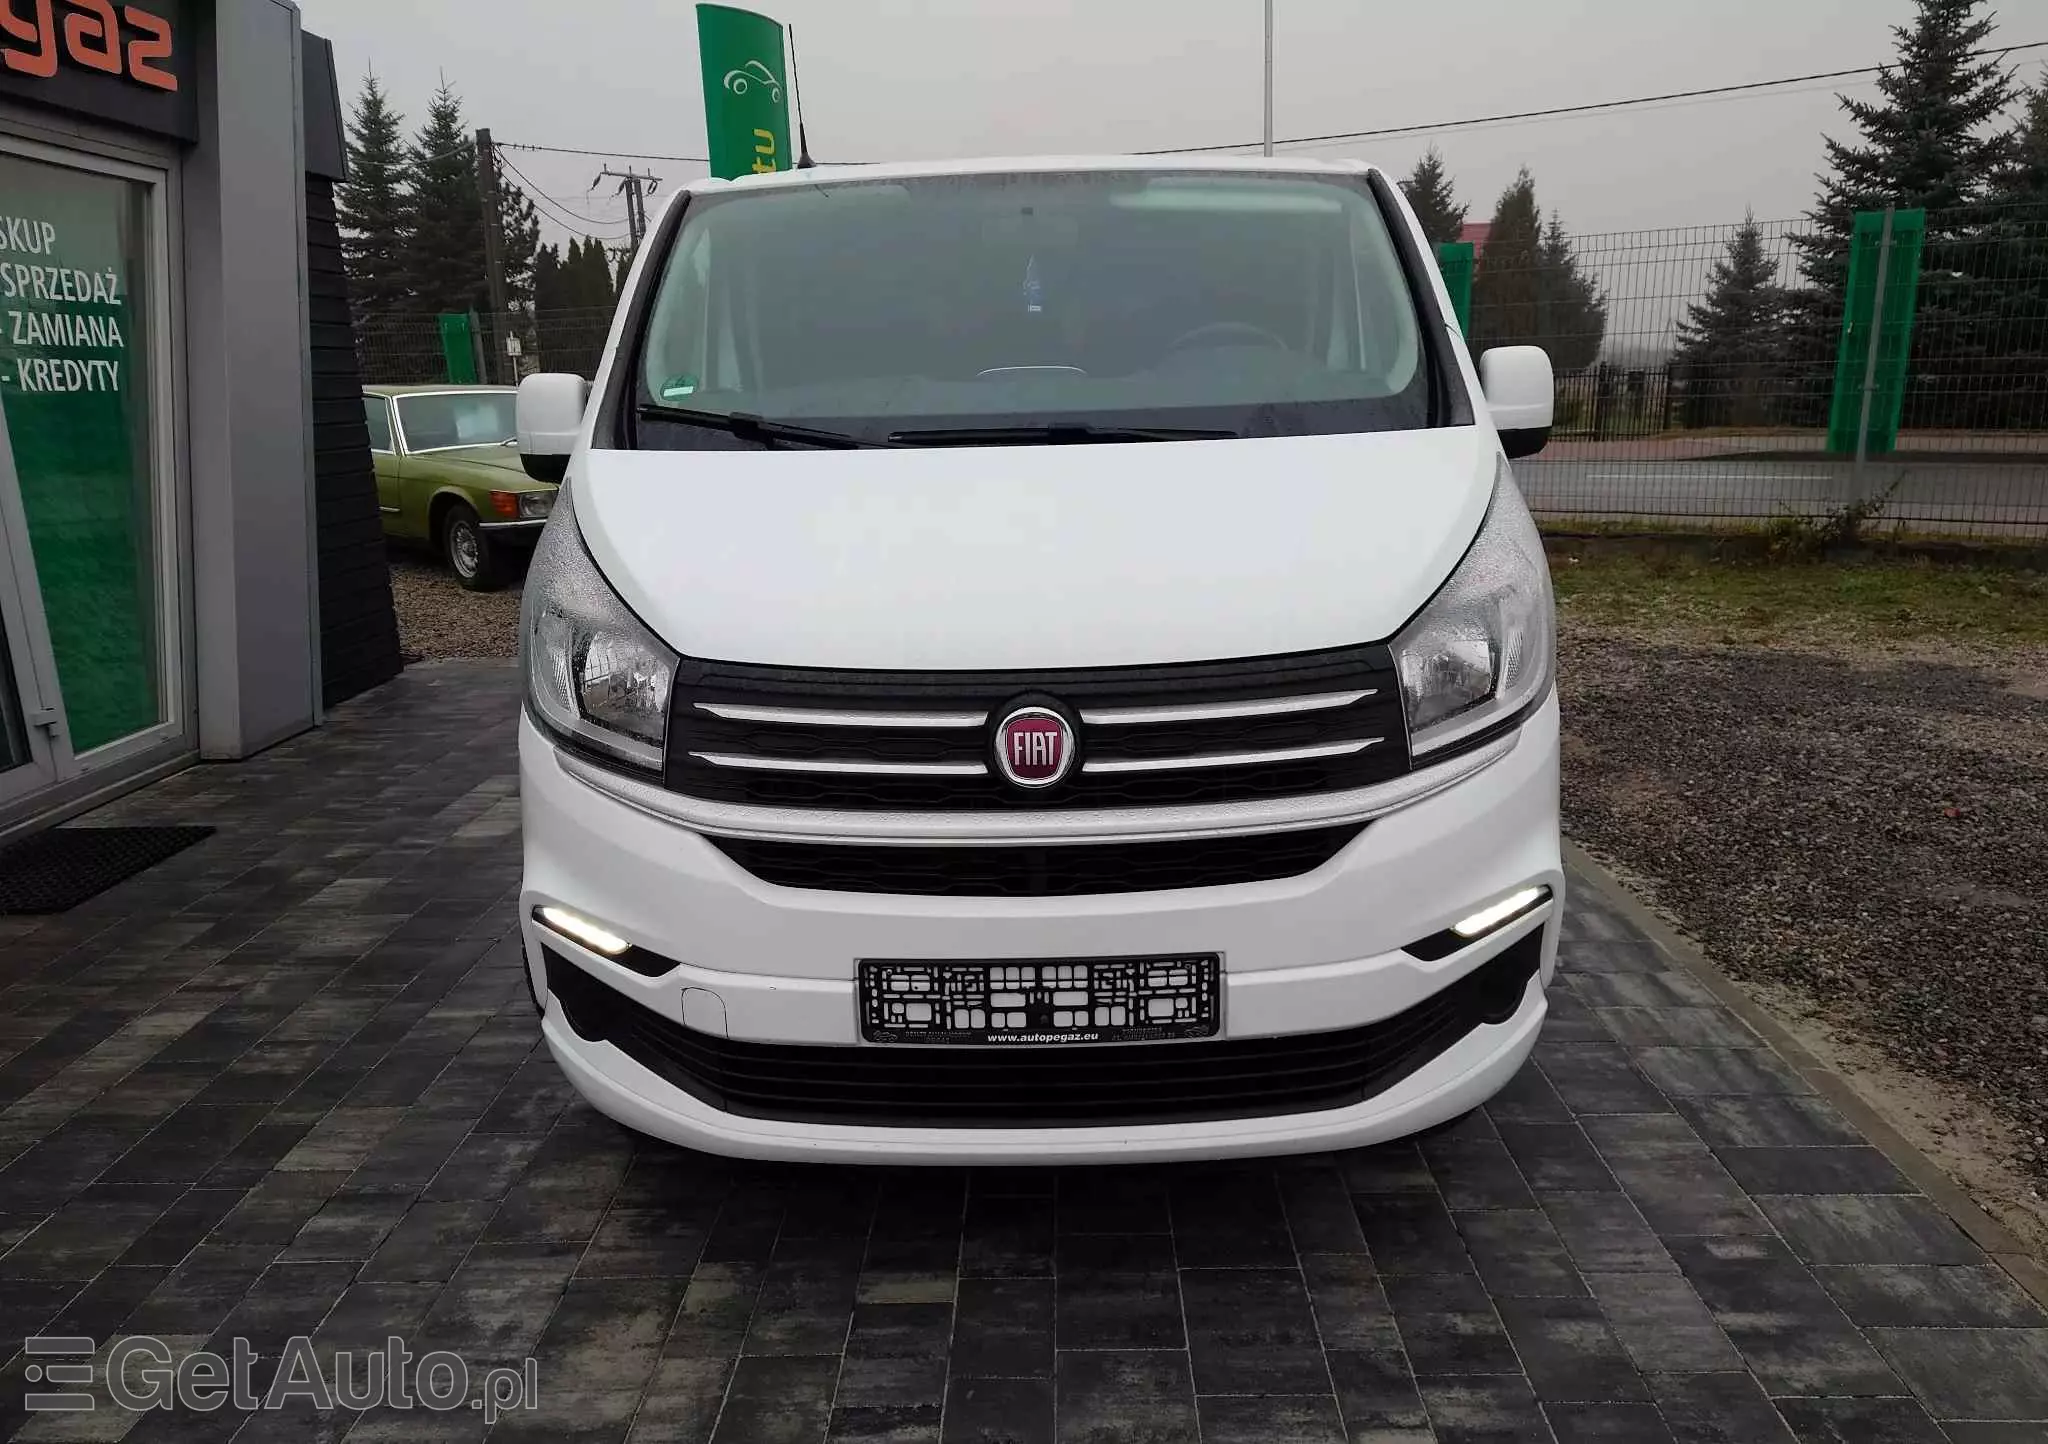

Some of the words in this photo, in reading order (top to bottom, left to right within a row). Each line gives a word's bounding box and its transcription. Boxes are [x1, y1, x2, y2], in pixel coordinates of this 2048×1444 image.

[1, 263, 121, 304] SPRZEDAŻ
[8, 310, 124, 348] ZAMIANA
[17, 358, 119, 392] KREDYTY
[1013, 731, 1058, 766] FIAT
[987, 1031, 1099, 1043] www.autopegaz.eu
